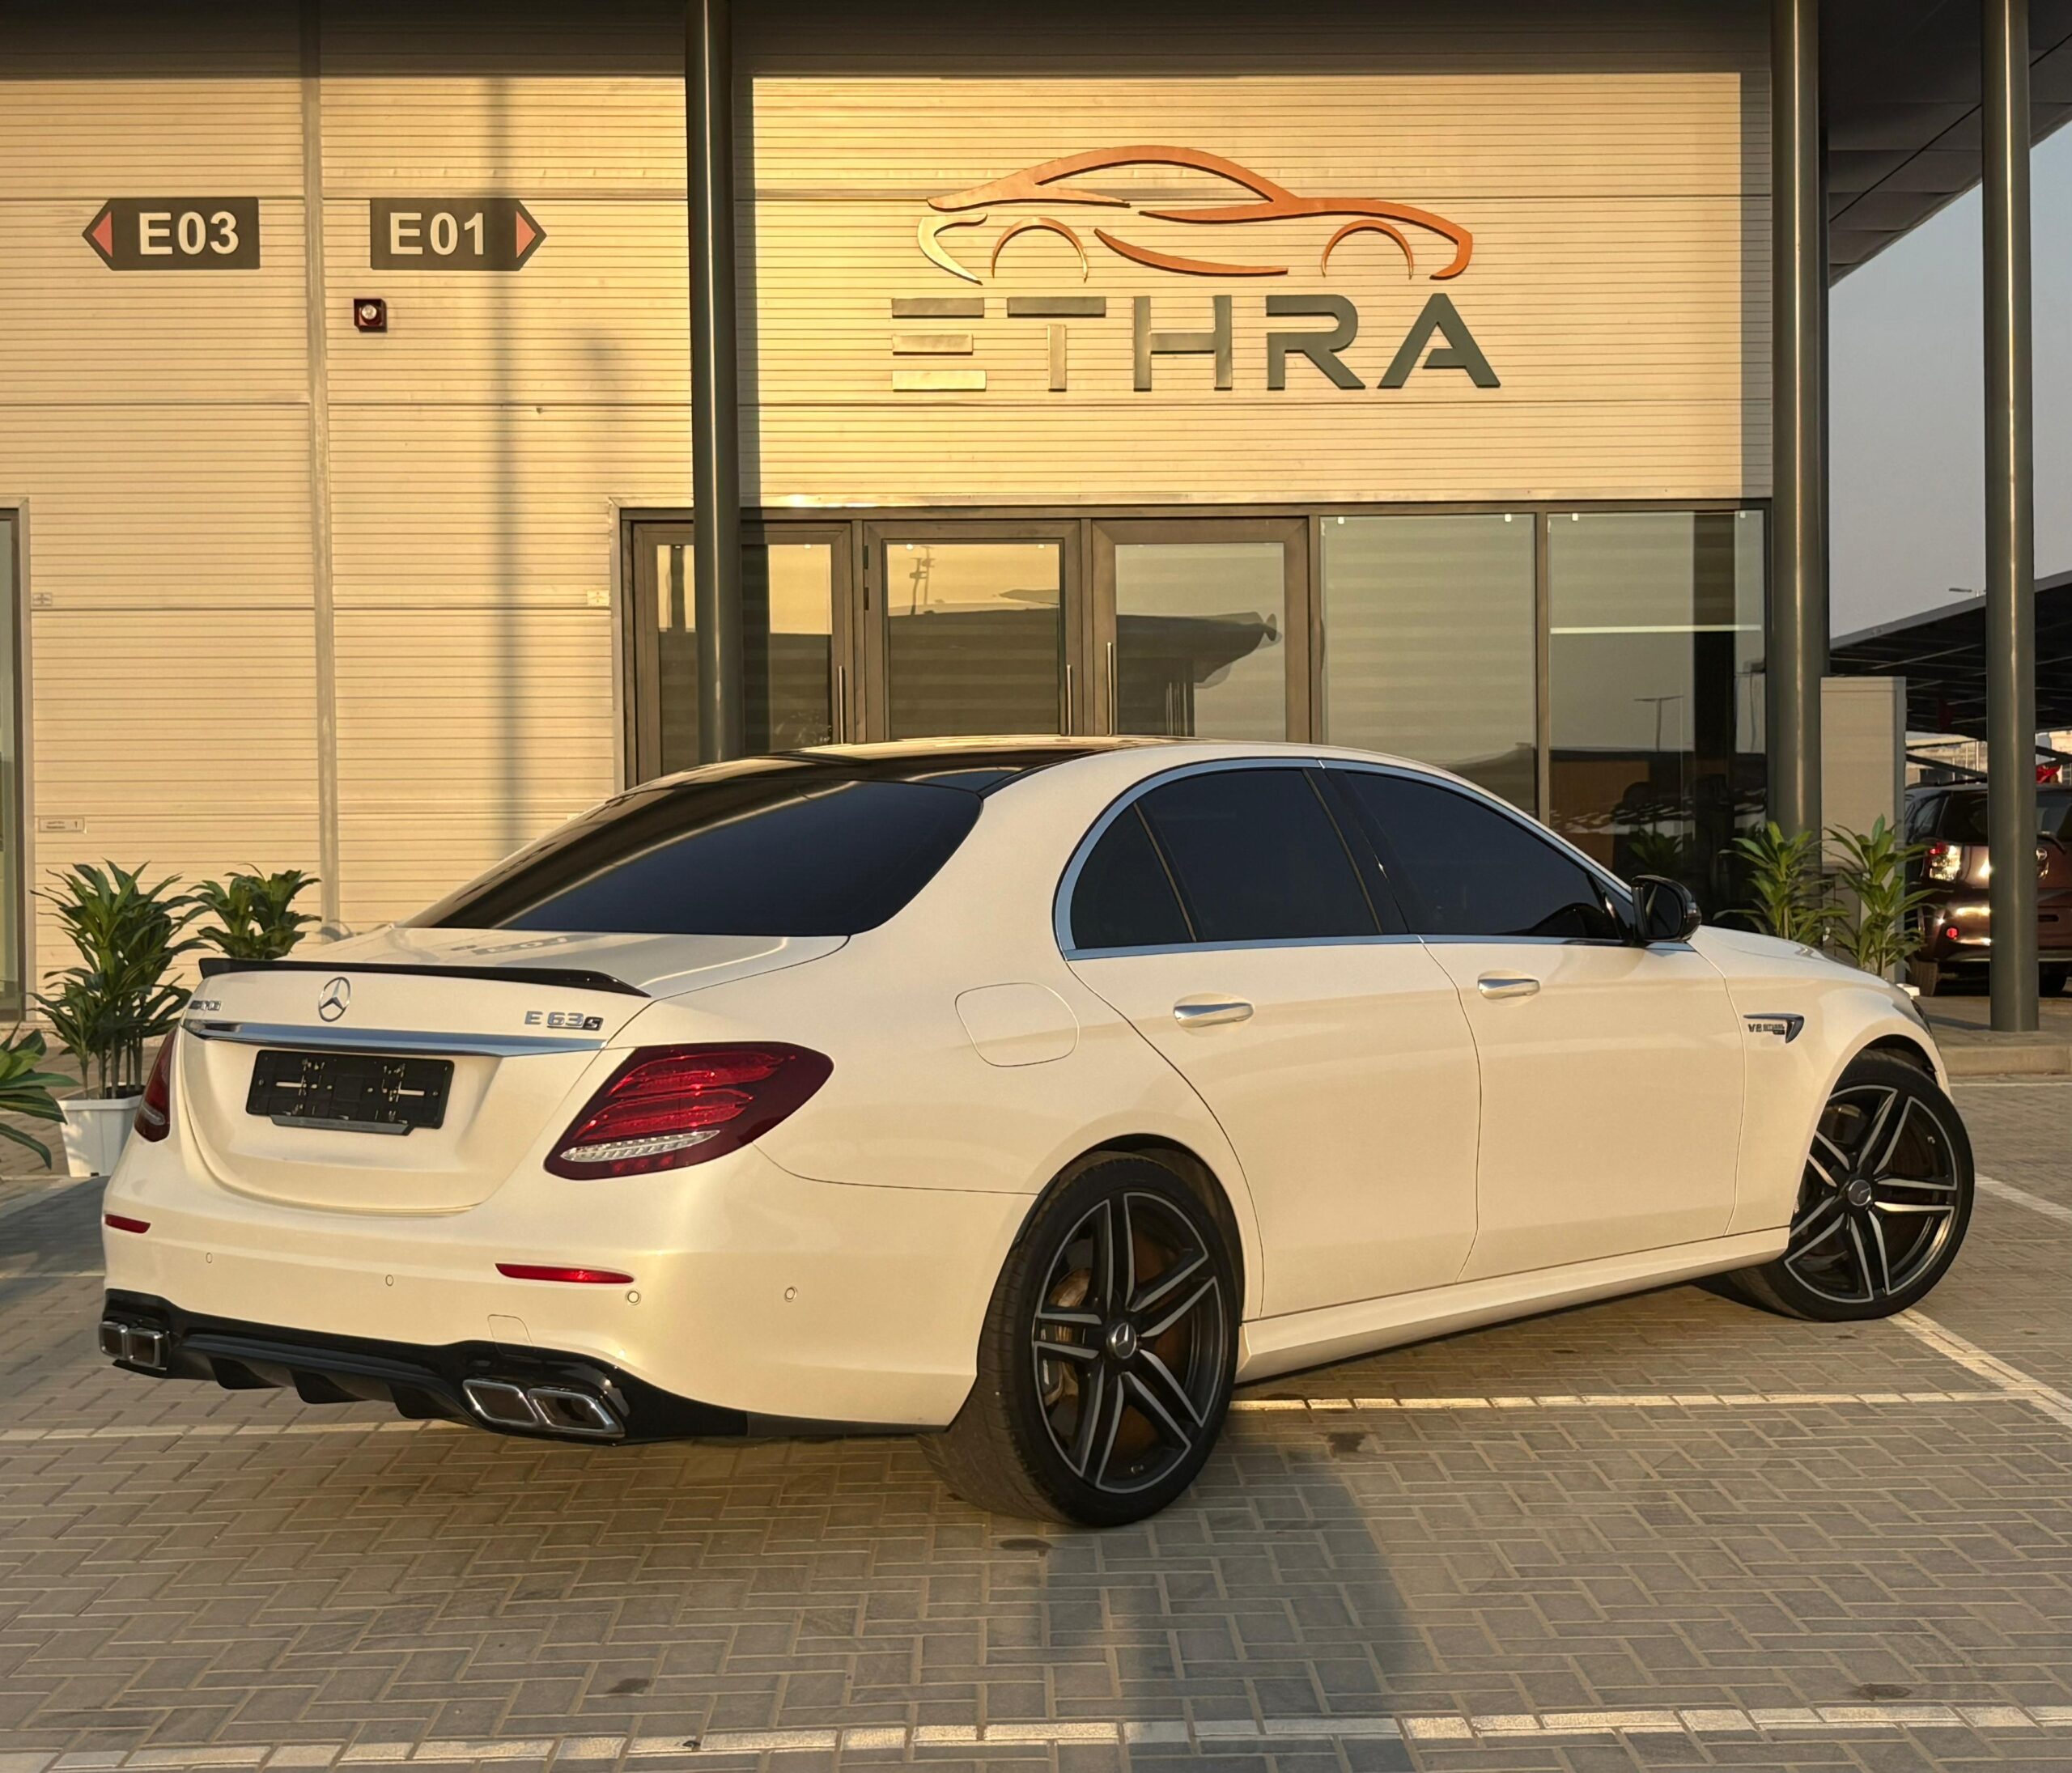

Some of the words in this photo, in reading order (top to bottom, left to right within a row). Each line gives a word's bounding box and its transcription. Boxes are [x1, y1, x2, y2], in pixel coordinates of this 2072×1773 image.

[138, 211, 240, 256] E03
[388, 211, 485, 256] E01
[891, 292, 1501, 392] ETHRA
